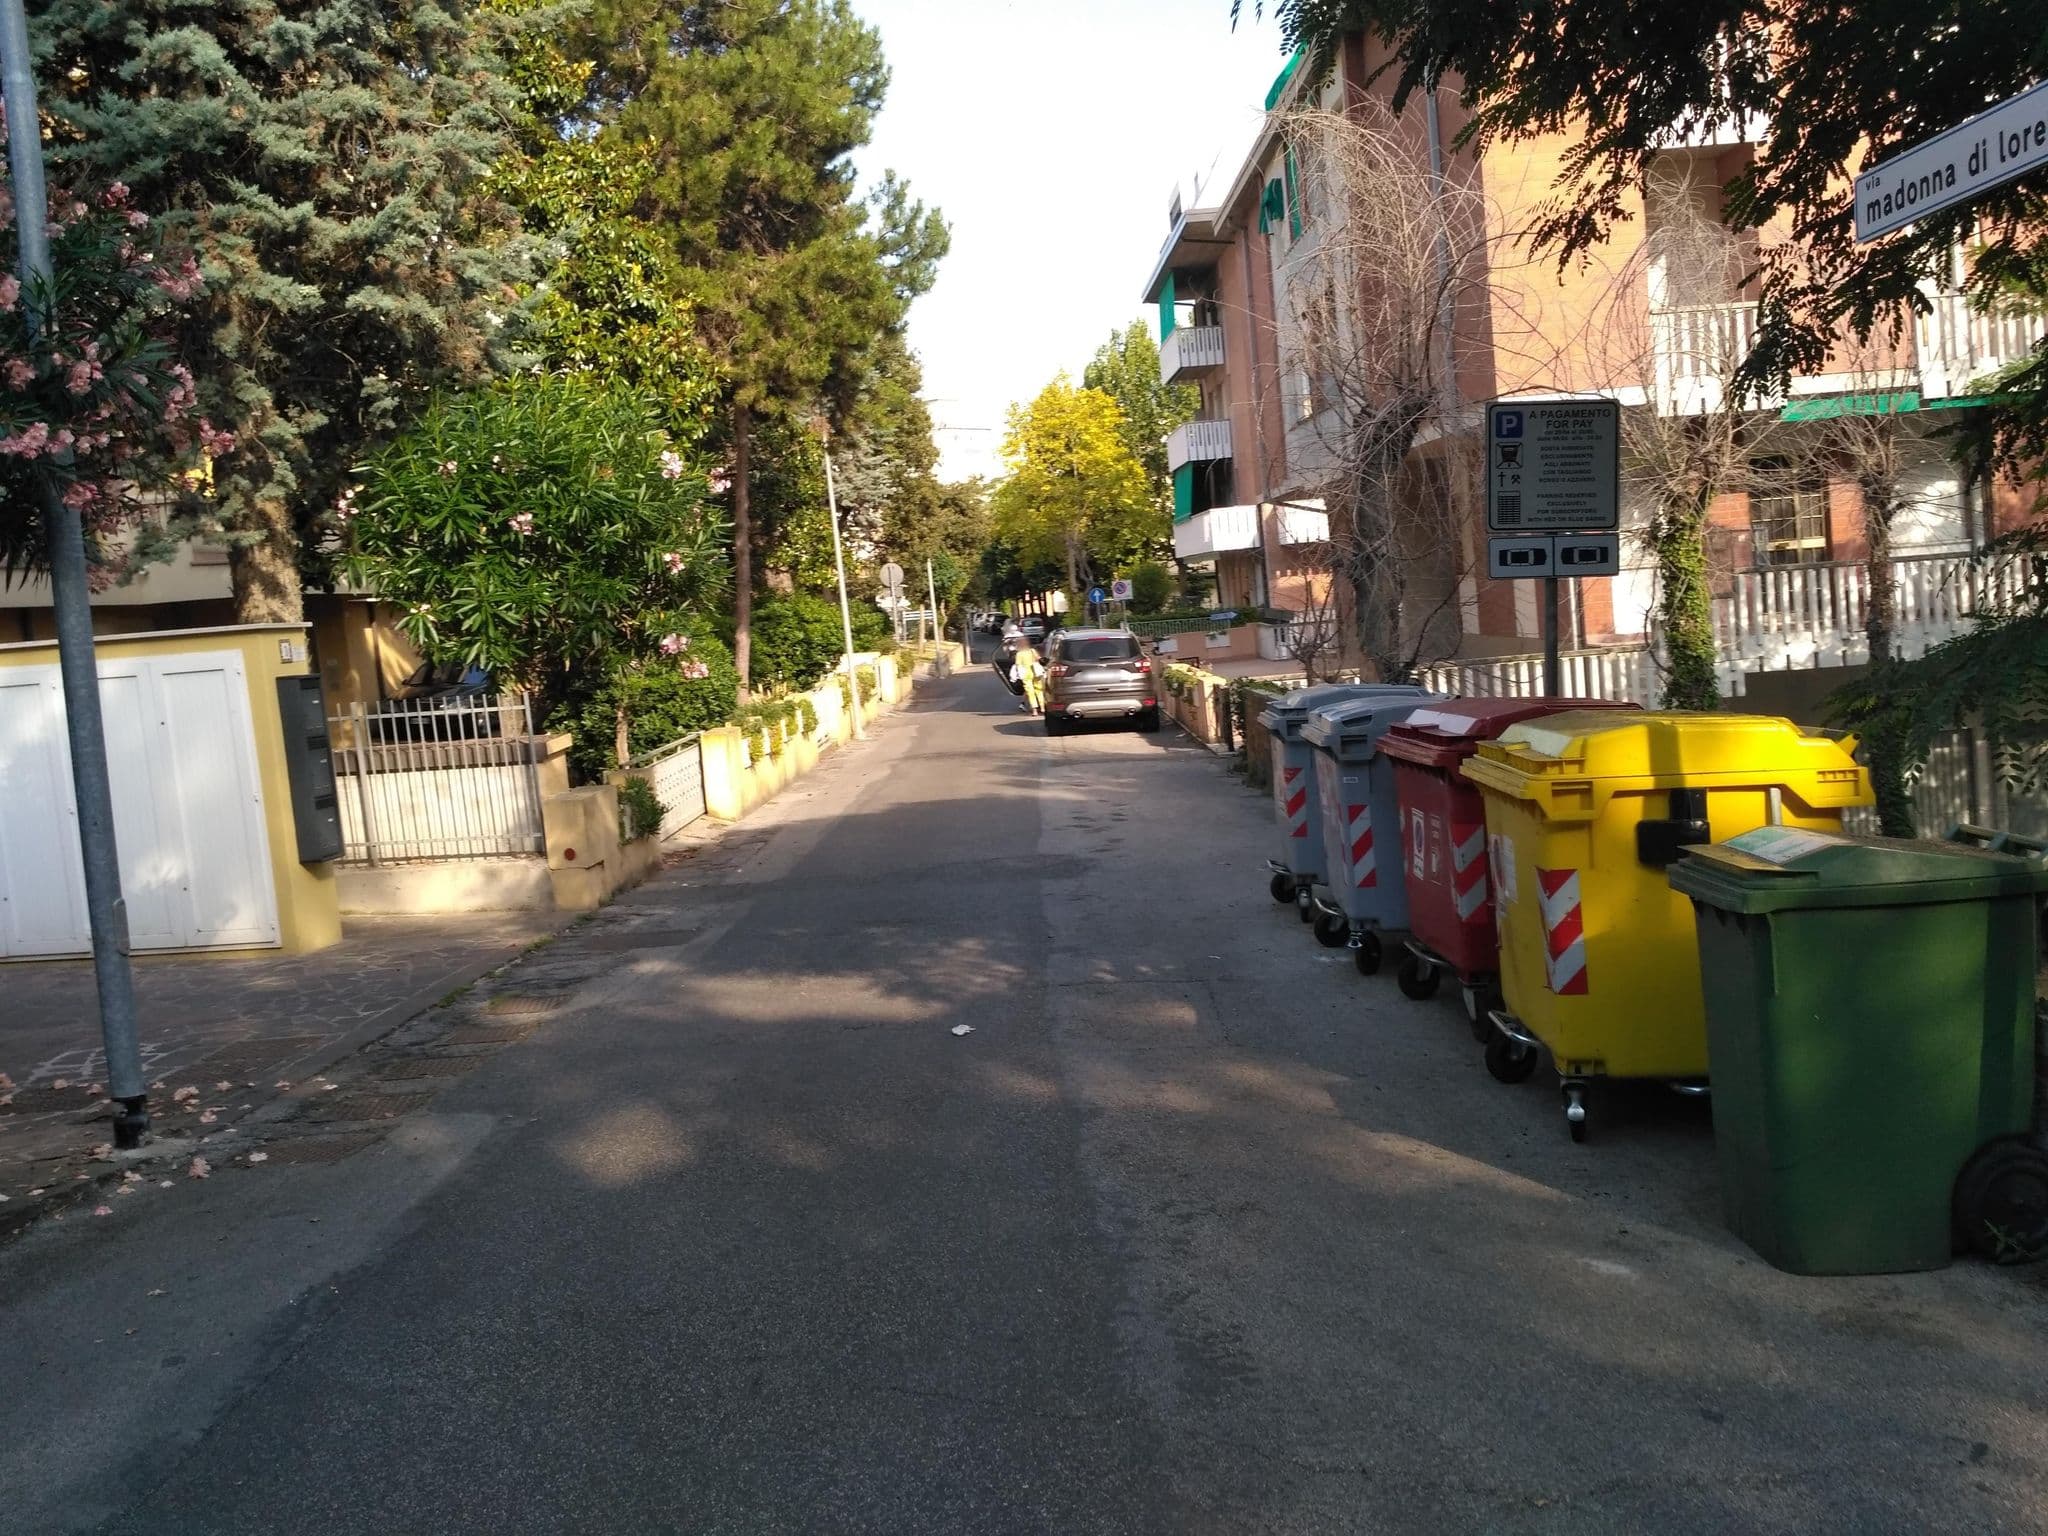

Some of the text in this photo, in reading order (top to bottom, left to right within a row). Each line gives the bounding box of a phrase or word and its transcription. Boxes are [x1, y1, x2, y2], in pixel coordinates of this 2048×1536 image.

[1866, 119, 2047, 224] madonna di lore
[1865, 175, 1881, 191] via
[1529, 409, 1611, 420] A PAGAMENTO
[1546, 419, 1594, 429] FOR PAY
